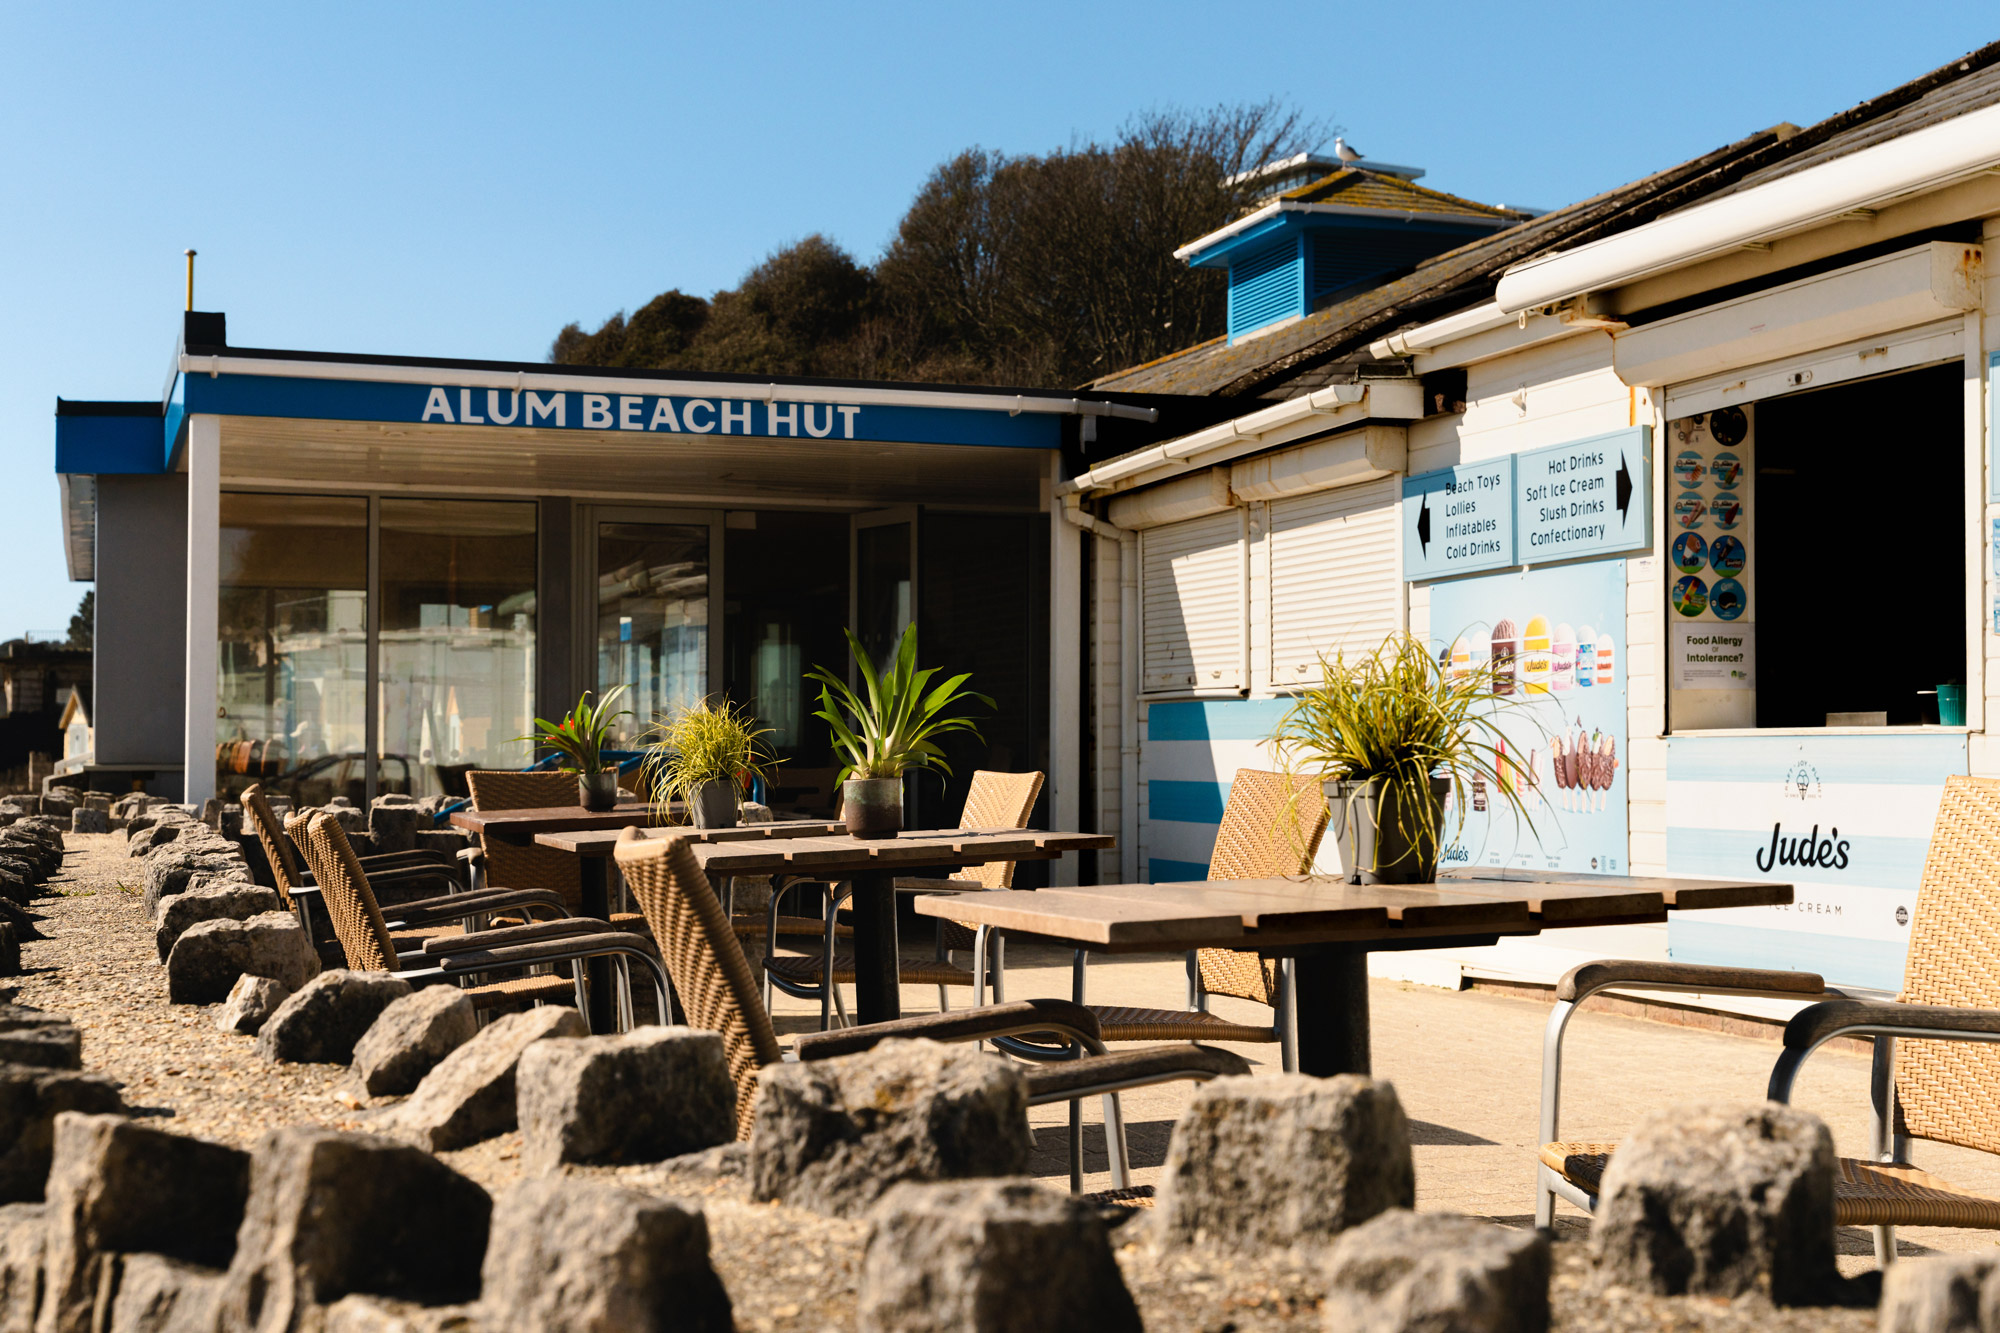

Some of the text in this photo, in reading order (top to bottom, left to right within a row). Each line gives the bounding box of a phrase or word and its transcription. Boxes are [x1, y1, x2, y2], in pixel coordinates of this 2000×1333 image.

[421, 387, 861, 439] ALUM BEACH HUT
[1548, 452, 1604, 475] Hot Drinks
[1445, 473, 1501, 496] Beach Toys
[1526, 476, 1605, 502] Soft Ice Cream
[1445, 499, 1476, 517] Lollies
[1539, 499, 1605, 523] Slush Drinks
[1446, 517, 1497, 539] Inflatables
[1530, 522, 1606, 547] Confectionary
[1446, 539, 1501, 560] Cold Drinks
[1686, 635, 1743, 648] Food Allergy
[1686, 653, 1744, 664] Intolerance?
[1439, 843, 1469, 863] Jude's
[1756, 822, 1850, 873] Jude's
[1798, 901, 1842, 916] CREAM
